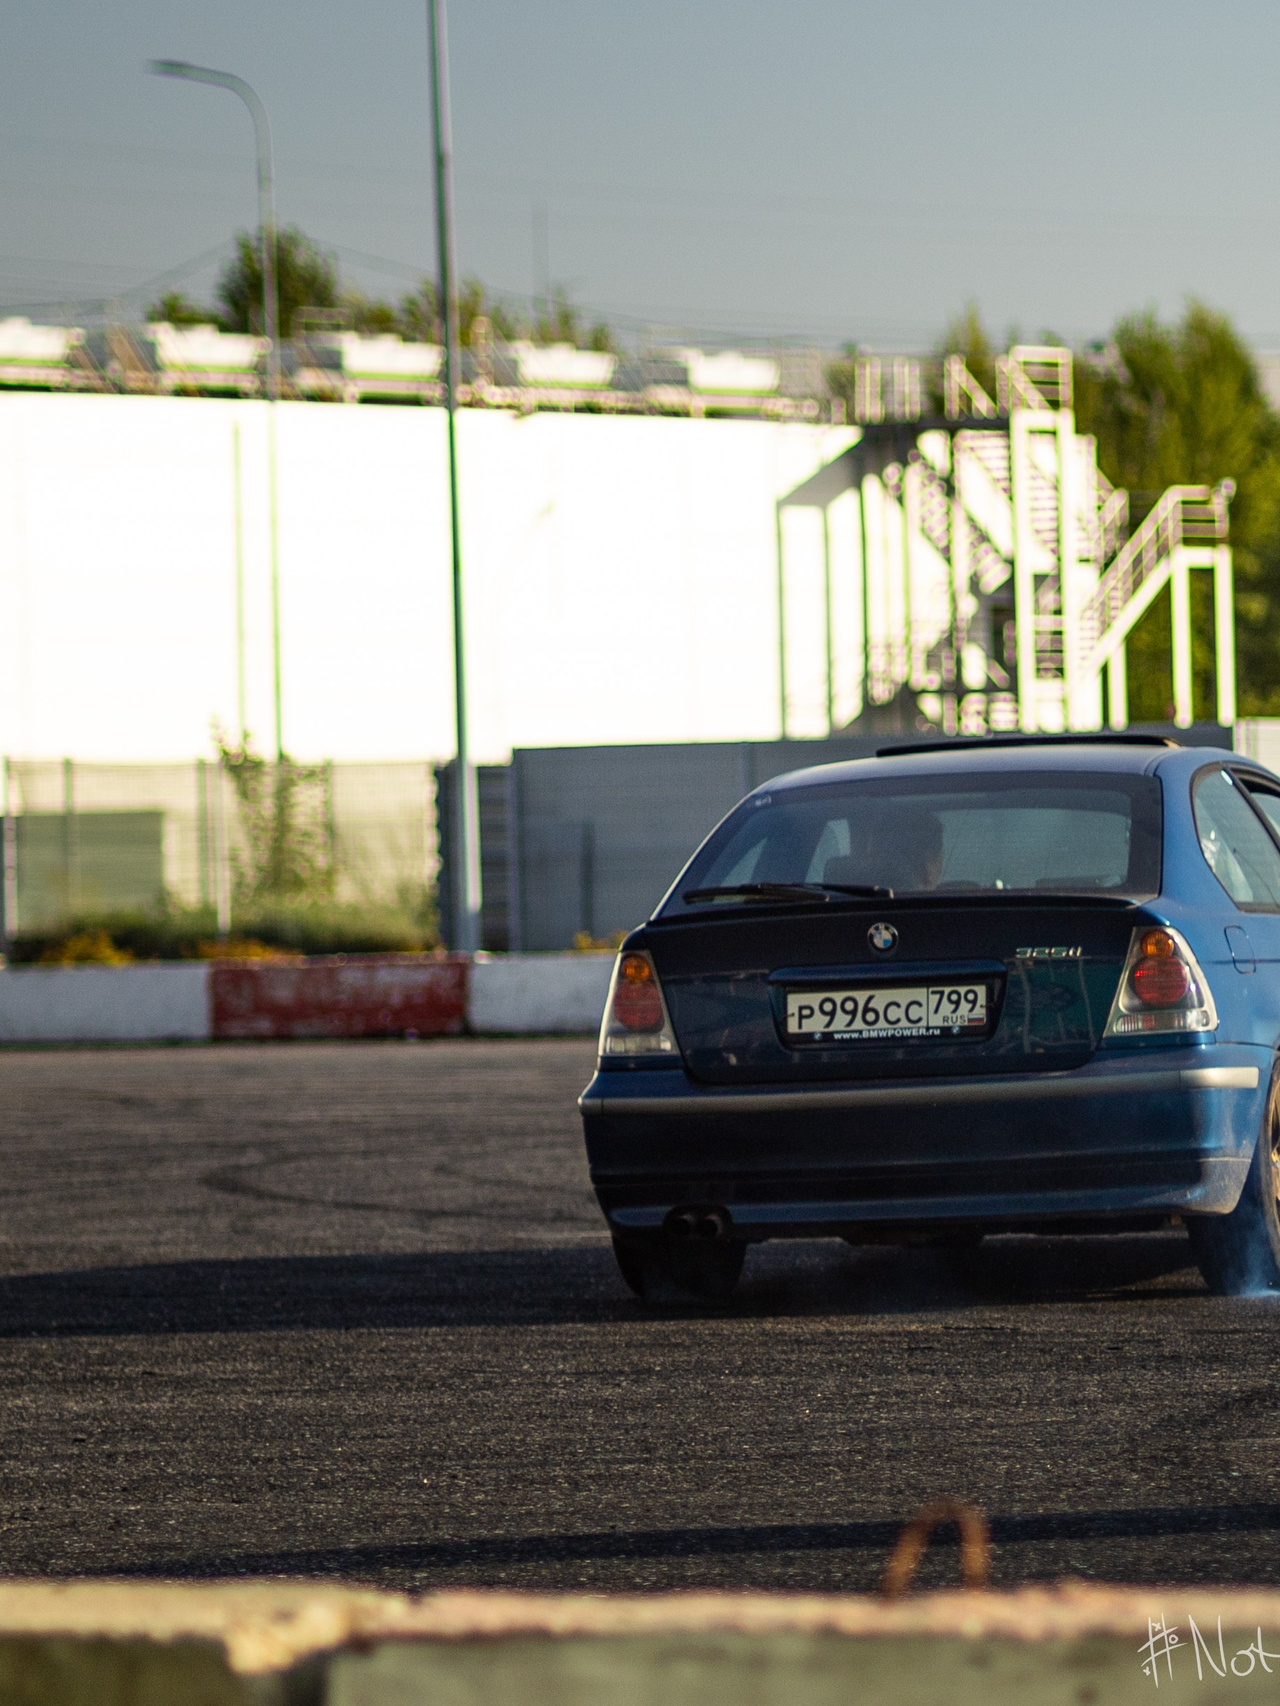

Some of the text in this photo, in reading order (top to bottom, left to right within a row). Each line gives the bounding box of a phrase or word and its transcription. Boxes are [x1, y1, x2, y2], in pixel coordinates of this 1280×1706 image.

[930, 988, 979, 1014] 799
[942, 1014, 967, 1025] RUS
[833, 1027, 941, 1040] www.BMWPOWER.ru
